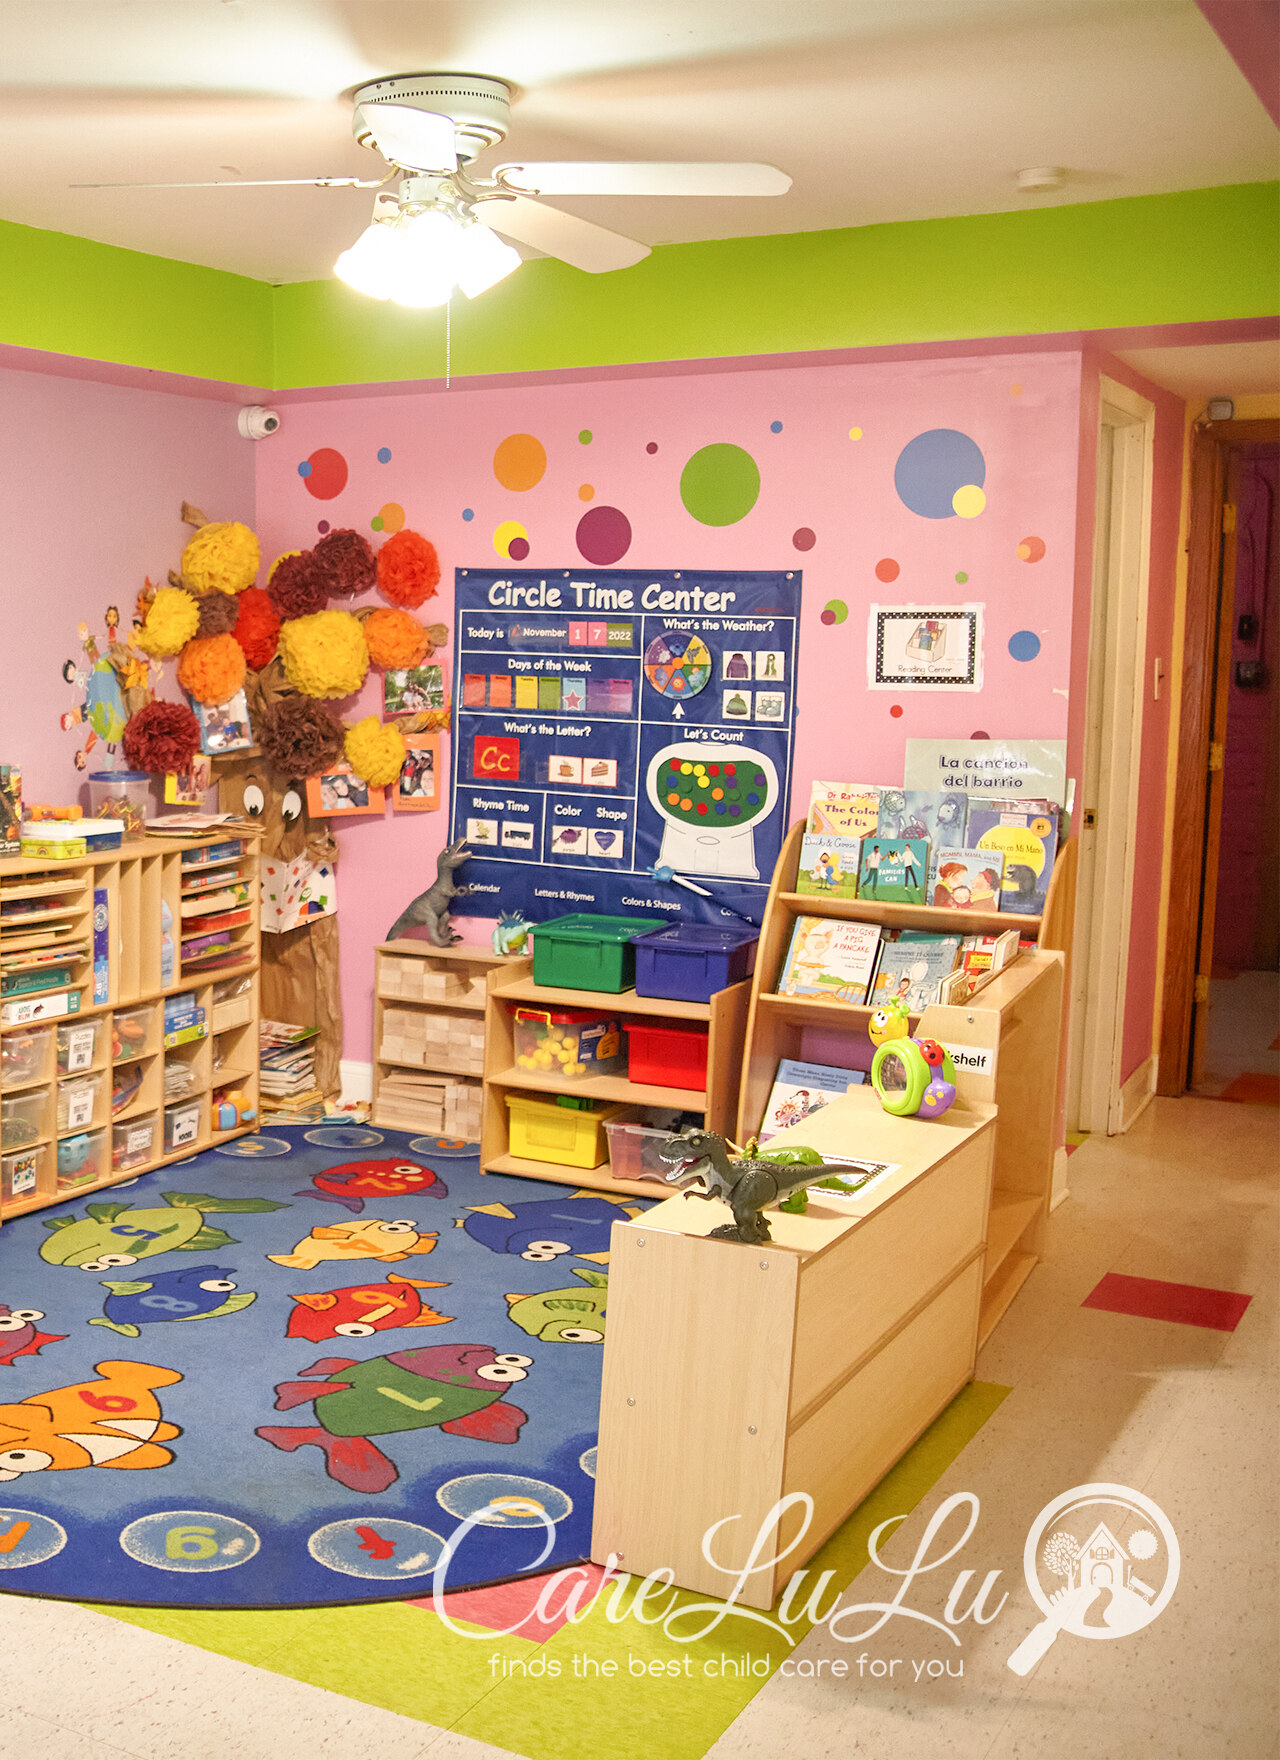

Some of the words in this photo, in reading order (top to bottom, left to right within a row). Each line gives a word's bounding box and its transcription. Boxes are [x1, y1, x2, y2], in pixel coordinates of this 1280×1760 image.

[488, 580, 562, 607] Circle
[570, 582, 634, 610] Time
[641, 583, 736, 612] Center
[663, 619, 700, 630] What's
[702, 620, 720, 630] the
[722, 620, 774, 632] Weather?
[467, 627, 495, 640] Today
[496, 628, 504, 638] is
[523, 628, 566, 638] November
[575, 630, 580, 640] 1
[593, 629, 602, 640] 7
[608, 631, 632, 641] 2022
[508, 659, 532, 673] Days
[534, 660, 544, 672] of
[545, 660, 562, 672] the
[564, 661, 592, 672] Week
[898, 665, 926, 675] Reading
[928, 665, 952, 673] Center
[504, 722, 536, 735] What's
[538, 724, 554, 736] the
[556, 724, 592, 737] Letter?
[684, 728, 707, 740] Let's
[710, 729, 744, 742] Count
[480, 746, 511, 772] Cc
[940, 754, 959, 768] La
[943, 775, 968, 788] del
[973, 776, 1023, 788] barrio
[472, 798, 504, 812] Rhyme
[506, 800, 530, 812] Time
[554, 804, 582, 816] Color
[825, 804, 846, 812] The
[596, 807, 628, 821] Shape
[840, 818, 852, 826] of
[854, 818, 867, 826] Us
[979, 841, 989, 850] Un
[468, 882, 501, 894] Calendar
[534, 888, 558, 900] Letters
[566, 892, 595, 902] Rhymes
[622, 897, 644, 908] Colors
[653, 900, 681, 912] Shapes
[846, 926, 858, 934] YOU
[859, 928, 876, 936] GIVE
[840, 943, 870, 953] PANCAKE
[140, 1294, 199, 1312] 8
